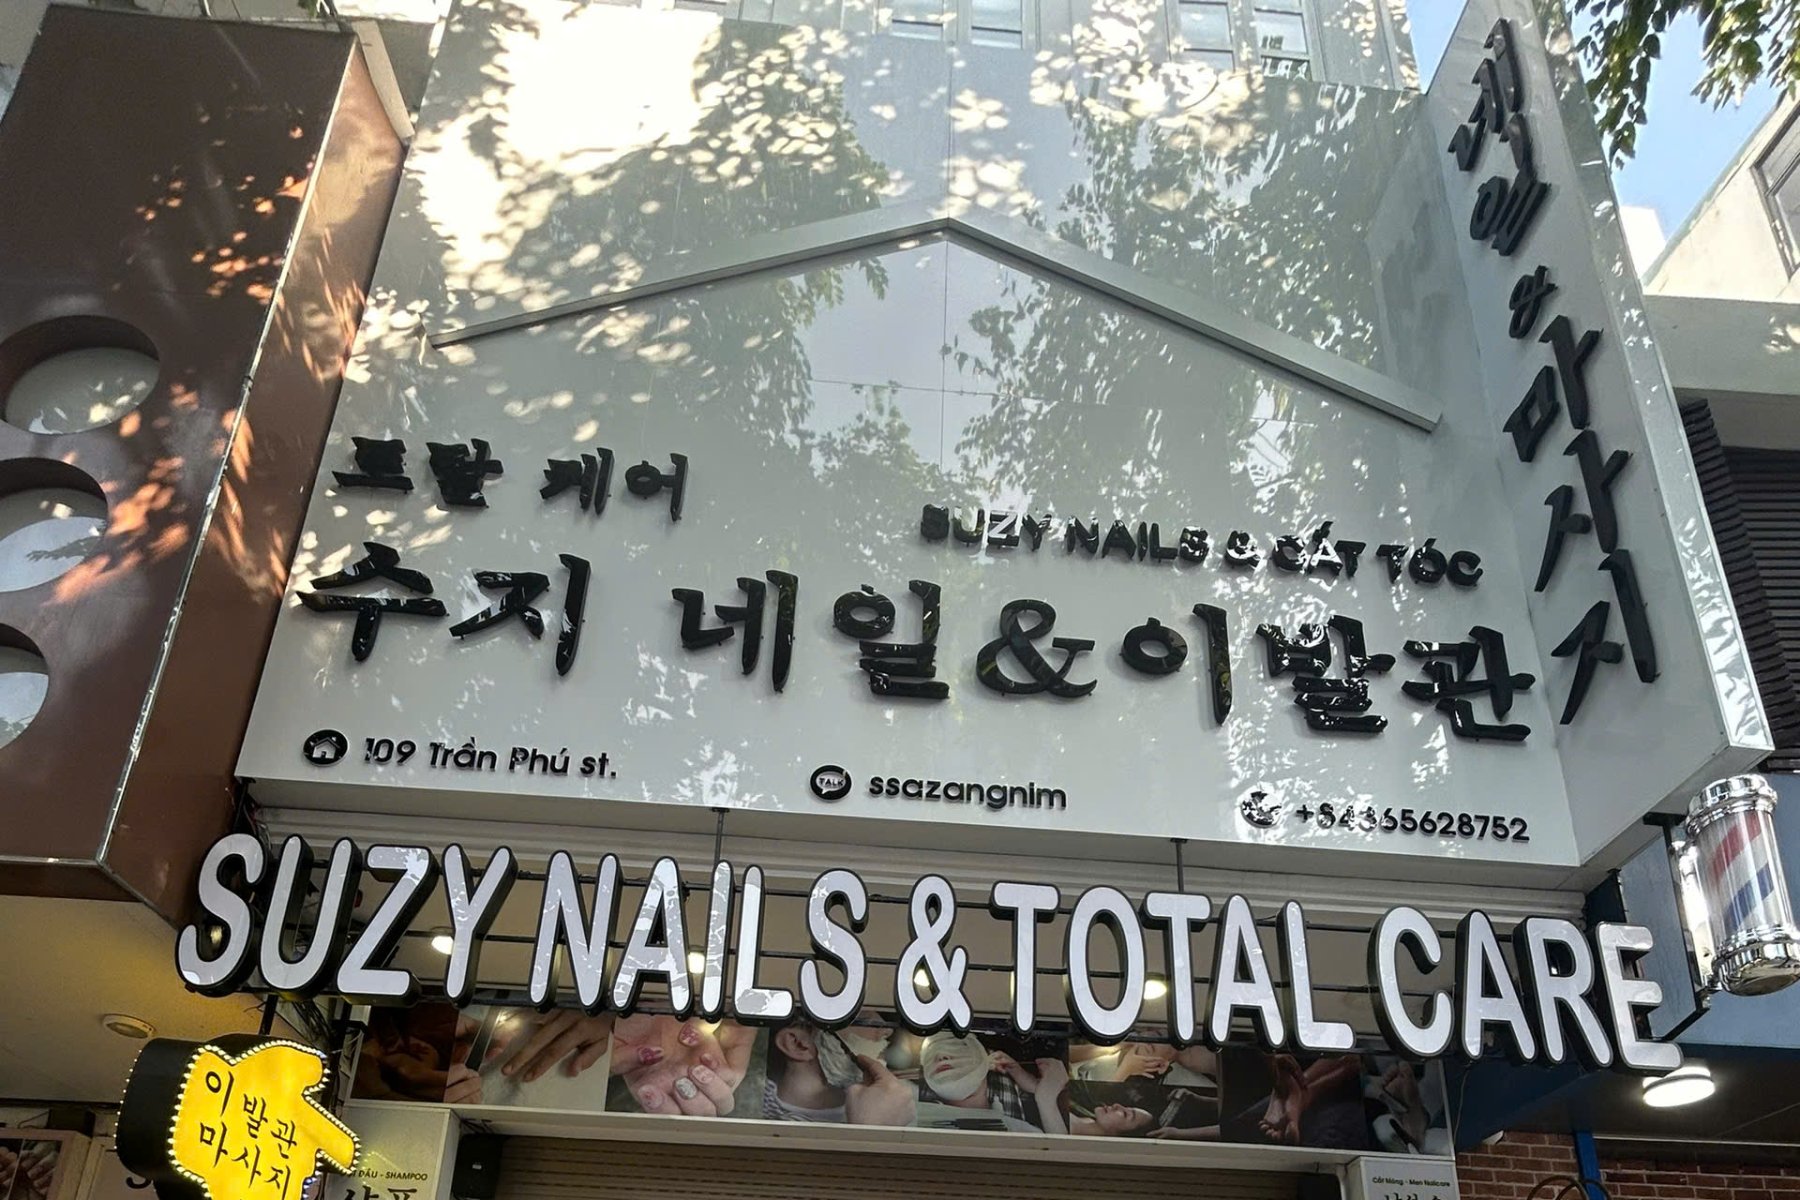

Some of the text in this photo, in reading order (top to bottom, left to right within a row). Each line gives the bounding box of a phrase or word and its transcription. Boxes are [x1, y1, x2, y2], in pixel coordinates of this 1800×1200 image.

[1066, 516, 1209, 564] NAILS
[1504, 315, 1661, 725] 마사지
[299, 541, 591, 676] 수지
[364, 737, 617, 779] 109 Trần Phú st.
[868, 775, 1067, 811] ssazangnim
[175, 833, 1683, 1076] SUZY NAILS & TOTAL CARE
[205, 1070, 297, 1160] 이발관
[385, 1171, 428, 1181] SHAMPOO
